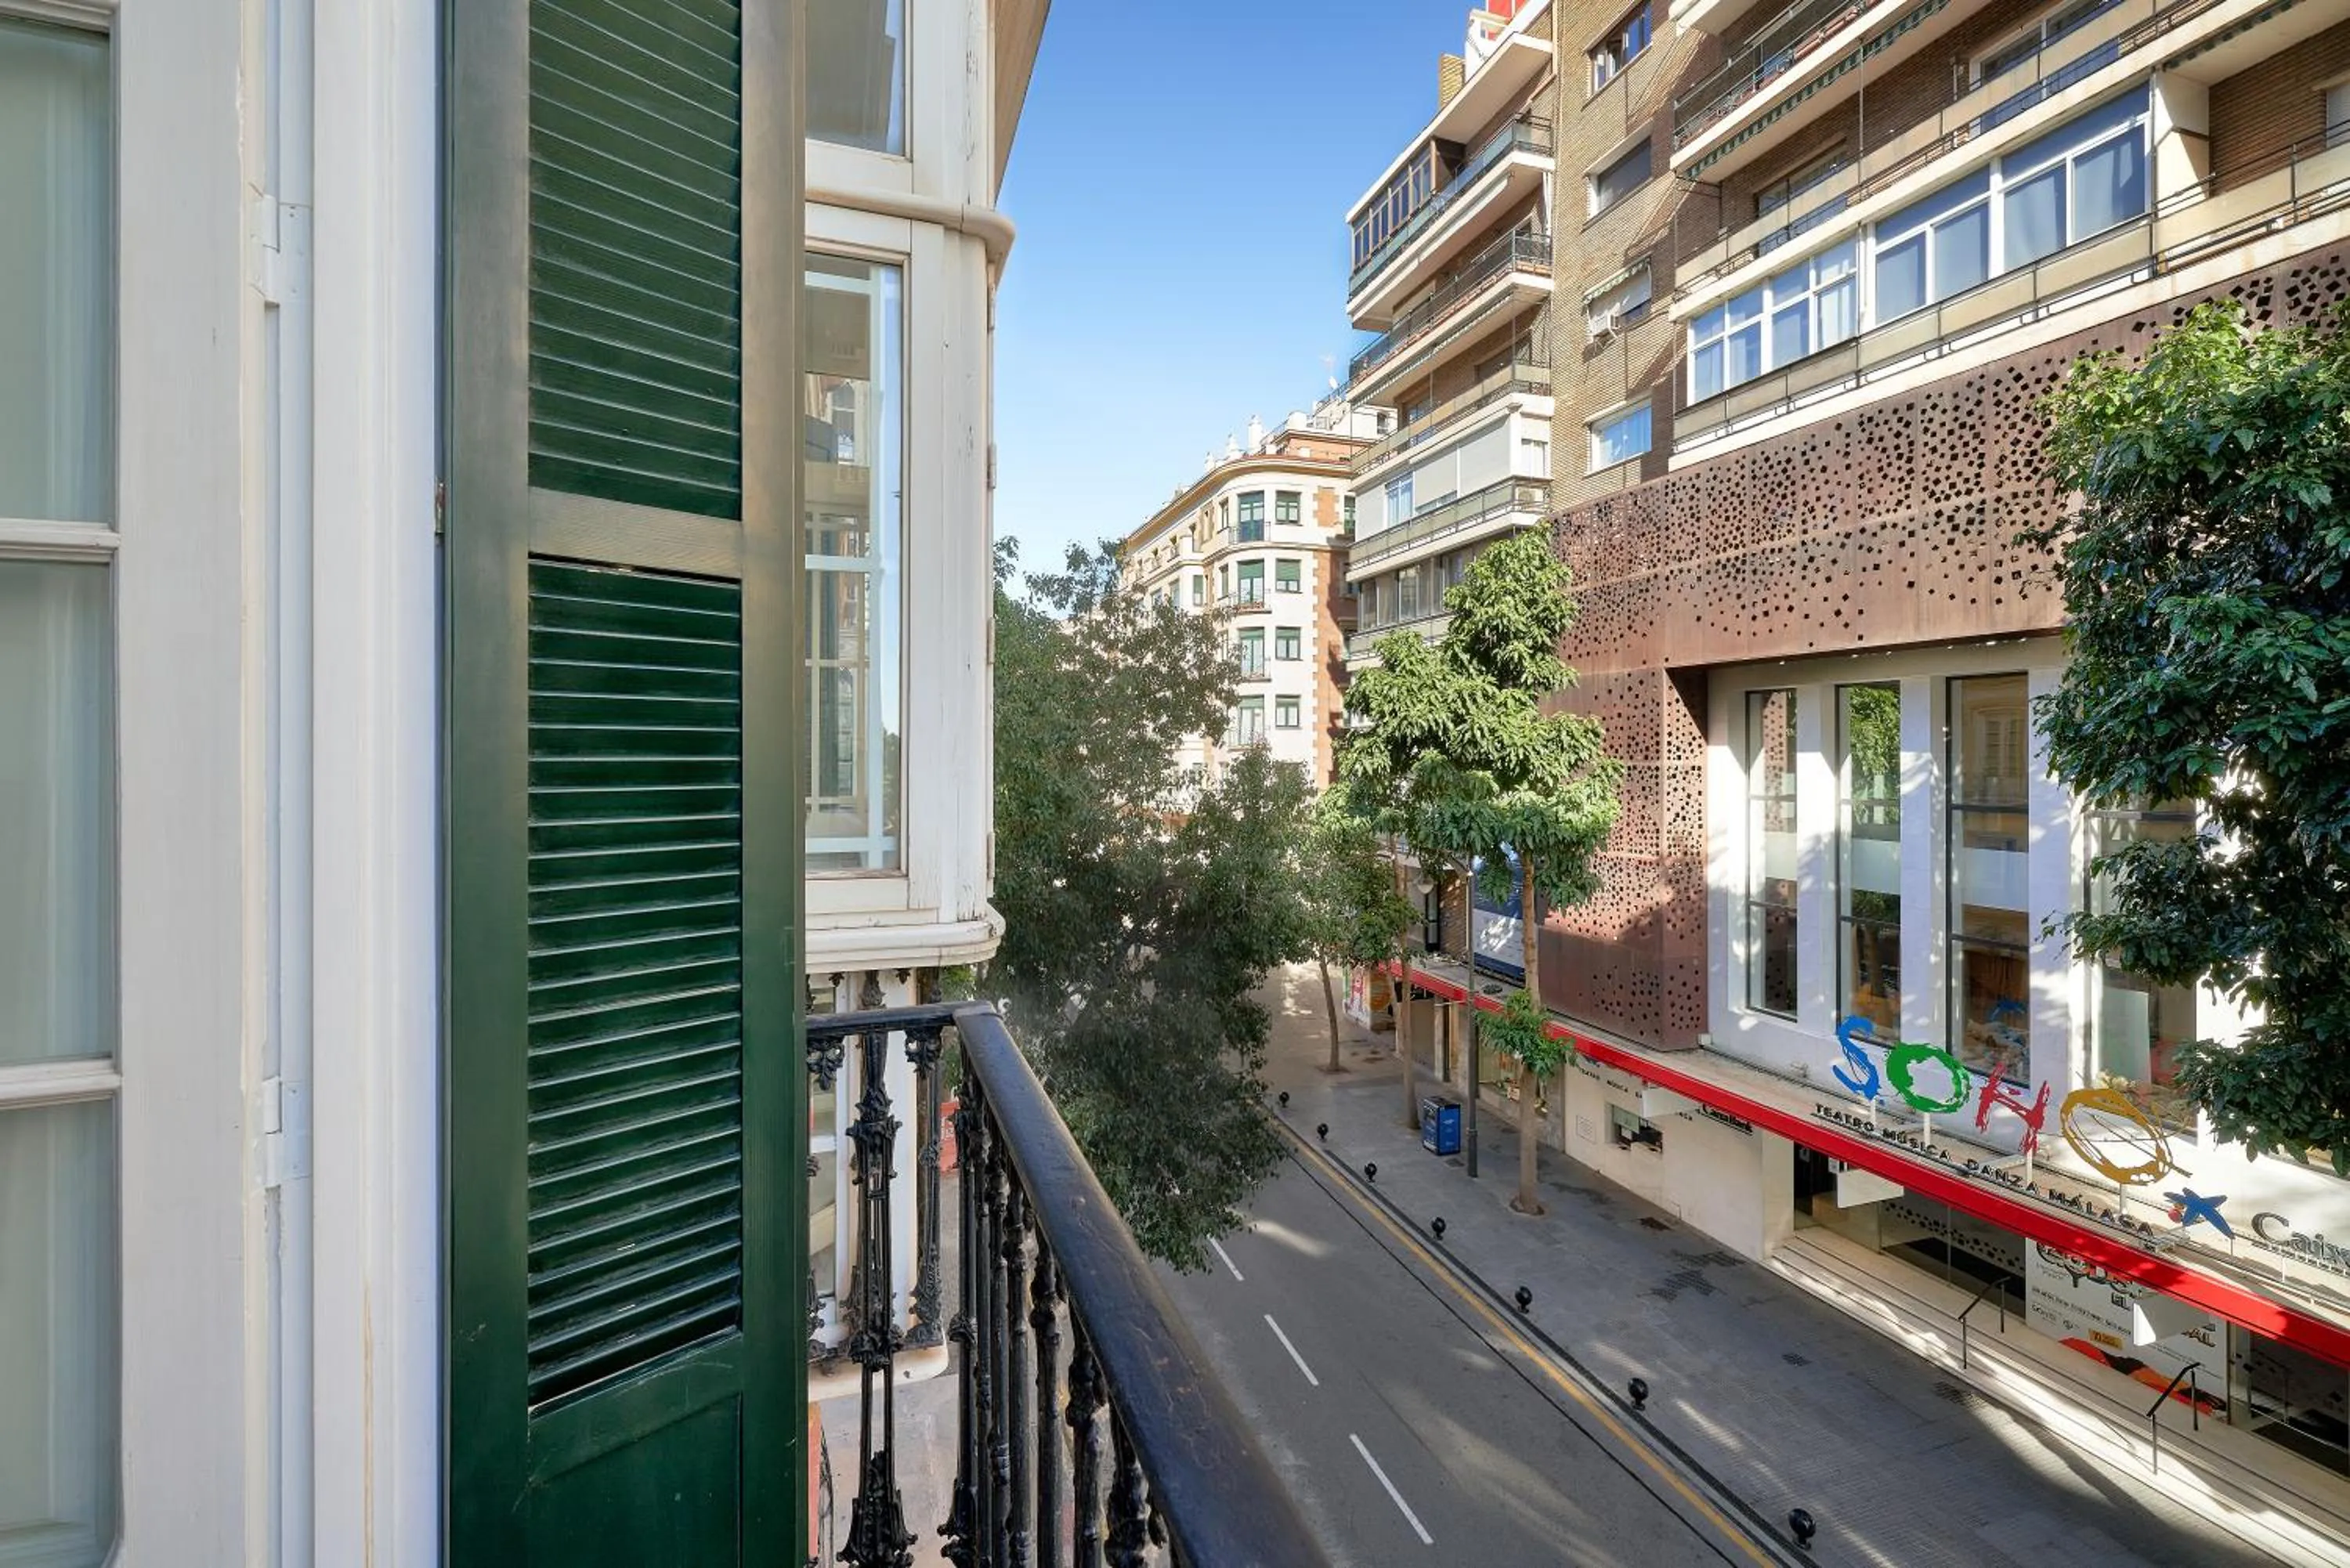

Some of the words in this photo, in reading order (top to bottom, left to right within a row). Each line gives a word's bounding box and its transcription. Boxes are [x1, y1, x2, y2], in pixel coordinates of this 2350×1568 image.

[1814, 1102, 1875, 1132] TEATRO
[1882, 1127, 1951, 1161] MÚSICA
[1965, 1158, 2038, 1194] DANZA
[1833, 1015, 2174, 1186] SOHO
